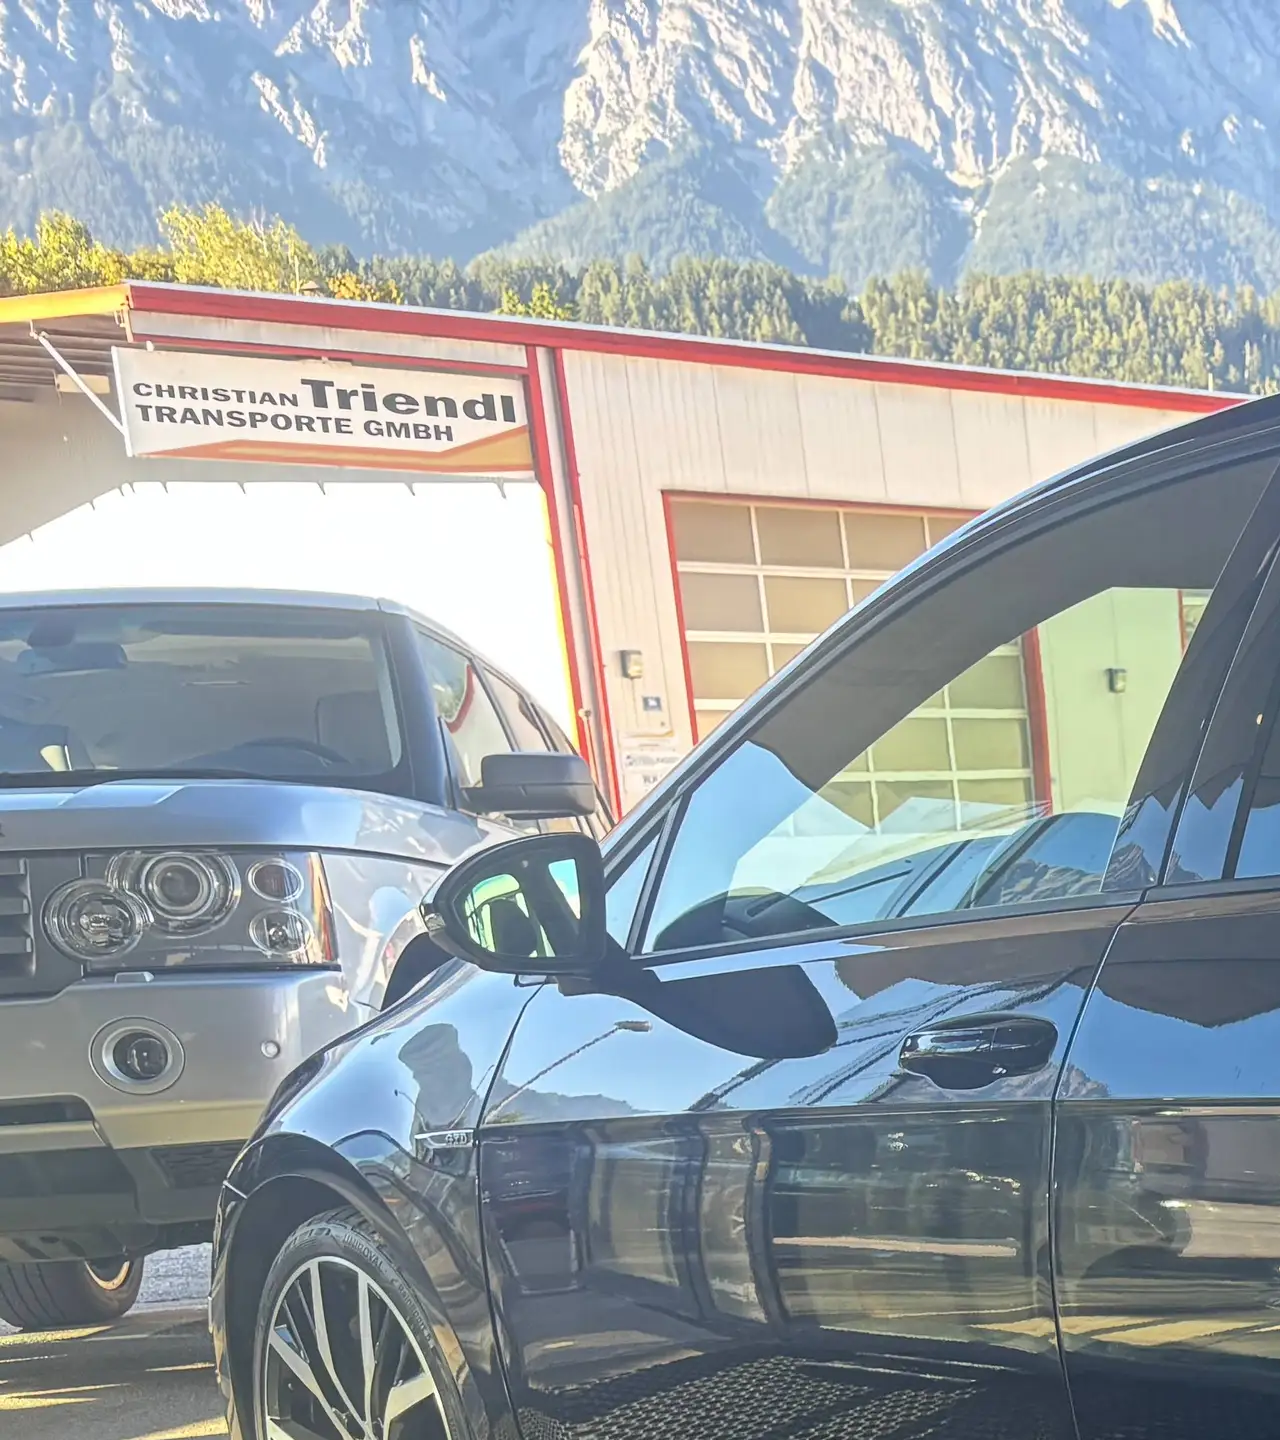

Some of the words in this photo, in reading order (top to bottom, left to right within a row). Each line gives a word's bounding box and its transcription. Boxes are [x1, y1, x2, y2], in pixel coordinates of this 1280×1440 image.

[132, 381, 299, 408] CHRISTIAN
[300, 378, 517, 424] Triendl
[135, 403, 354, 436] TRANSPORTE
[362, 419, 454, 442] GMBH
